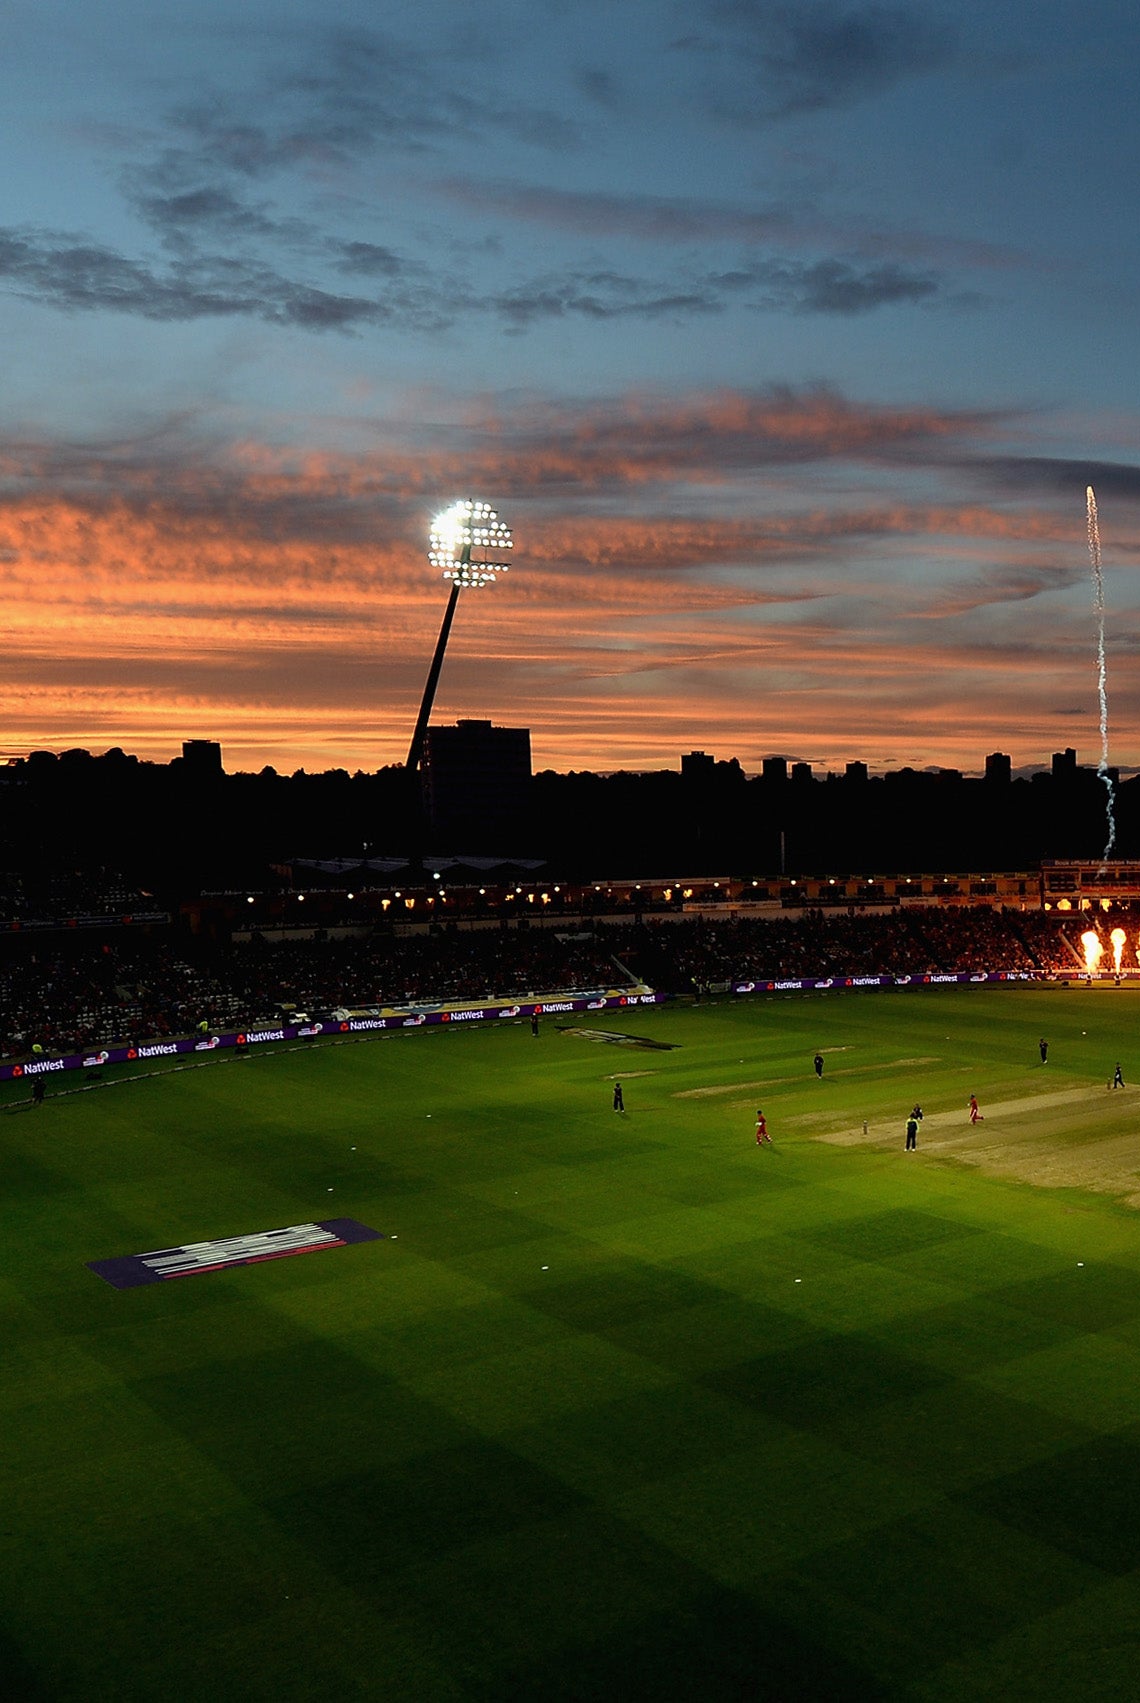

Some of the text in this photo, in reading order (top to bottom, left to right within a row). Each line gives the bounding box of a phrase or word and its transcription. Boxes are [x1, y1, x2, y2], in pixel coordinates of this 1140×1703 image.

[852, 975, 881, 985] NatWest
[930, 974, 958, 983] NatWest
[774, 981, 802, 990] NatWest
[542, 1002, 574, 1012] NatWest
[450, 1010, 484, 1021] NatWest
[350, 1018, 387, 1031] NatWest
[246, 1029, 285, 1043] NatWest
[138, 1043, 178, 1058] NatWest
[24, 1058, 65, 1075] NatWest
